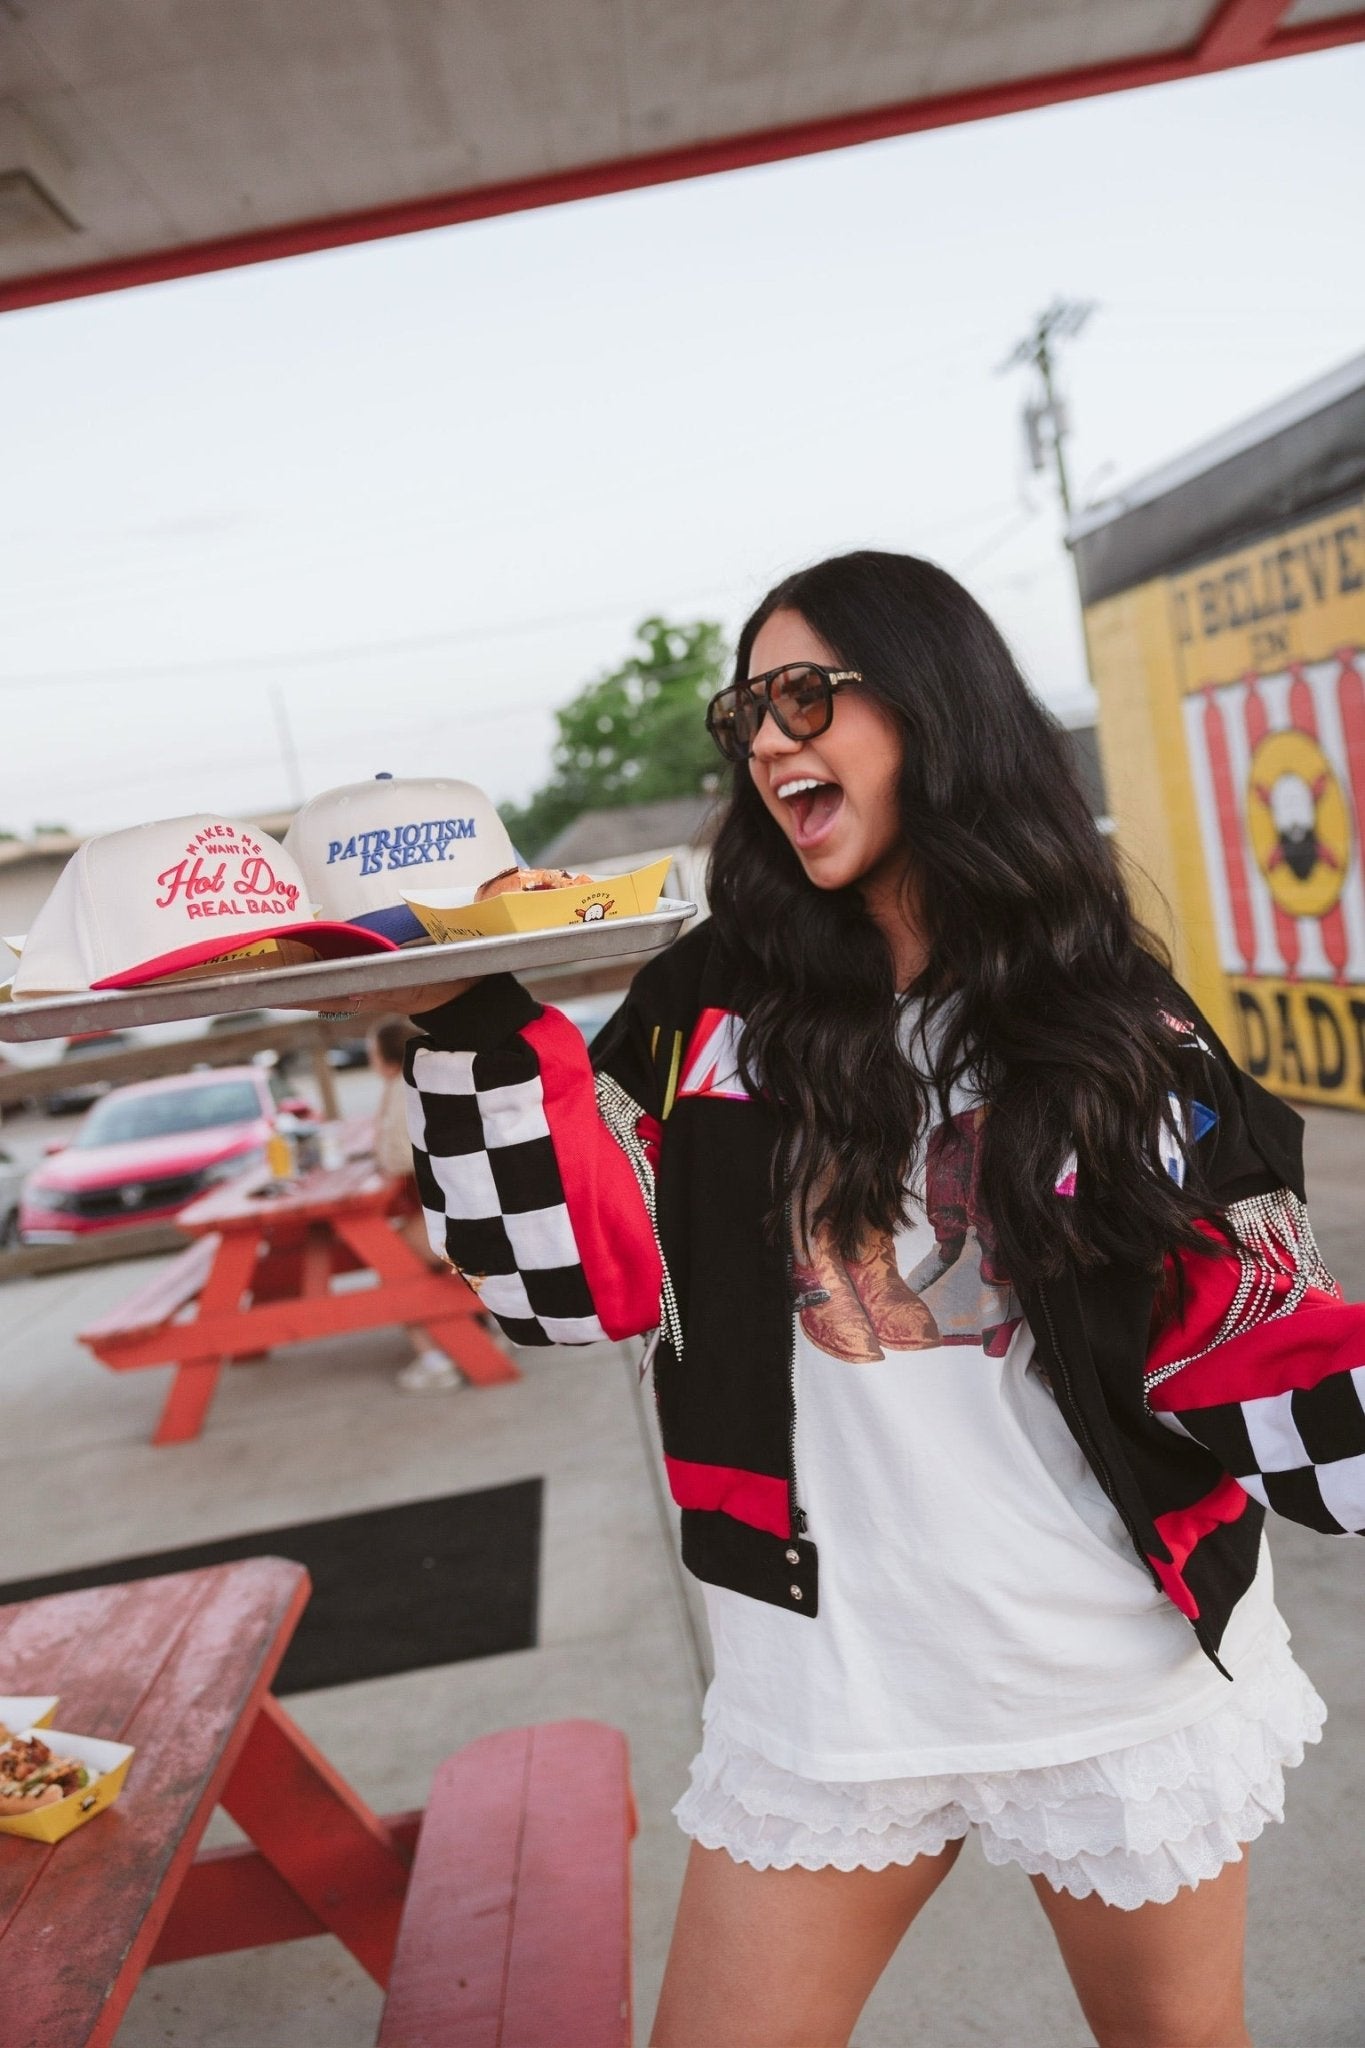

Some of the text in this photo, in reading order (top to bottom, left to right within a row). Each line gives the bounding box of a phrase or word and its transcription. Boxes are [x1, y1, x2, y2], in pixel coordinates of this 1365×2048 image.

[1197, 525, 1364, 638] BELIEVE
[186, 825, 262, 856] MAKES ME
[326, 818, 476, 864] PATRIOTISM
[359, 840, 455, 876] IS SEXY.
[156, 857, 300, 911] Hot Dog
[186, 899, 286, 919] REAL BAD
